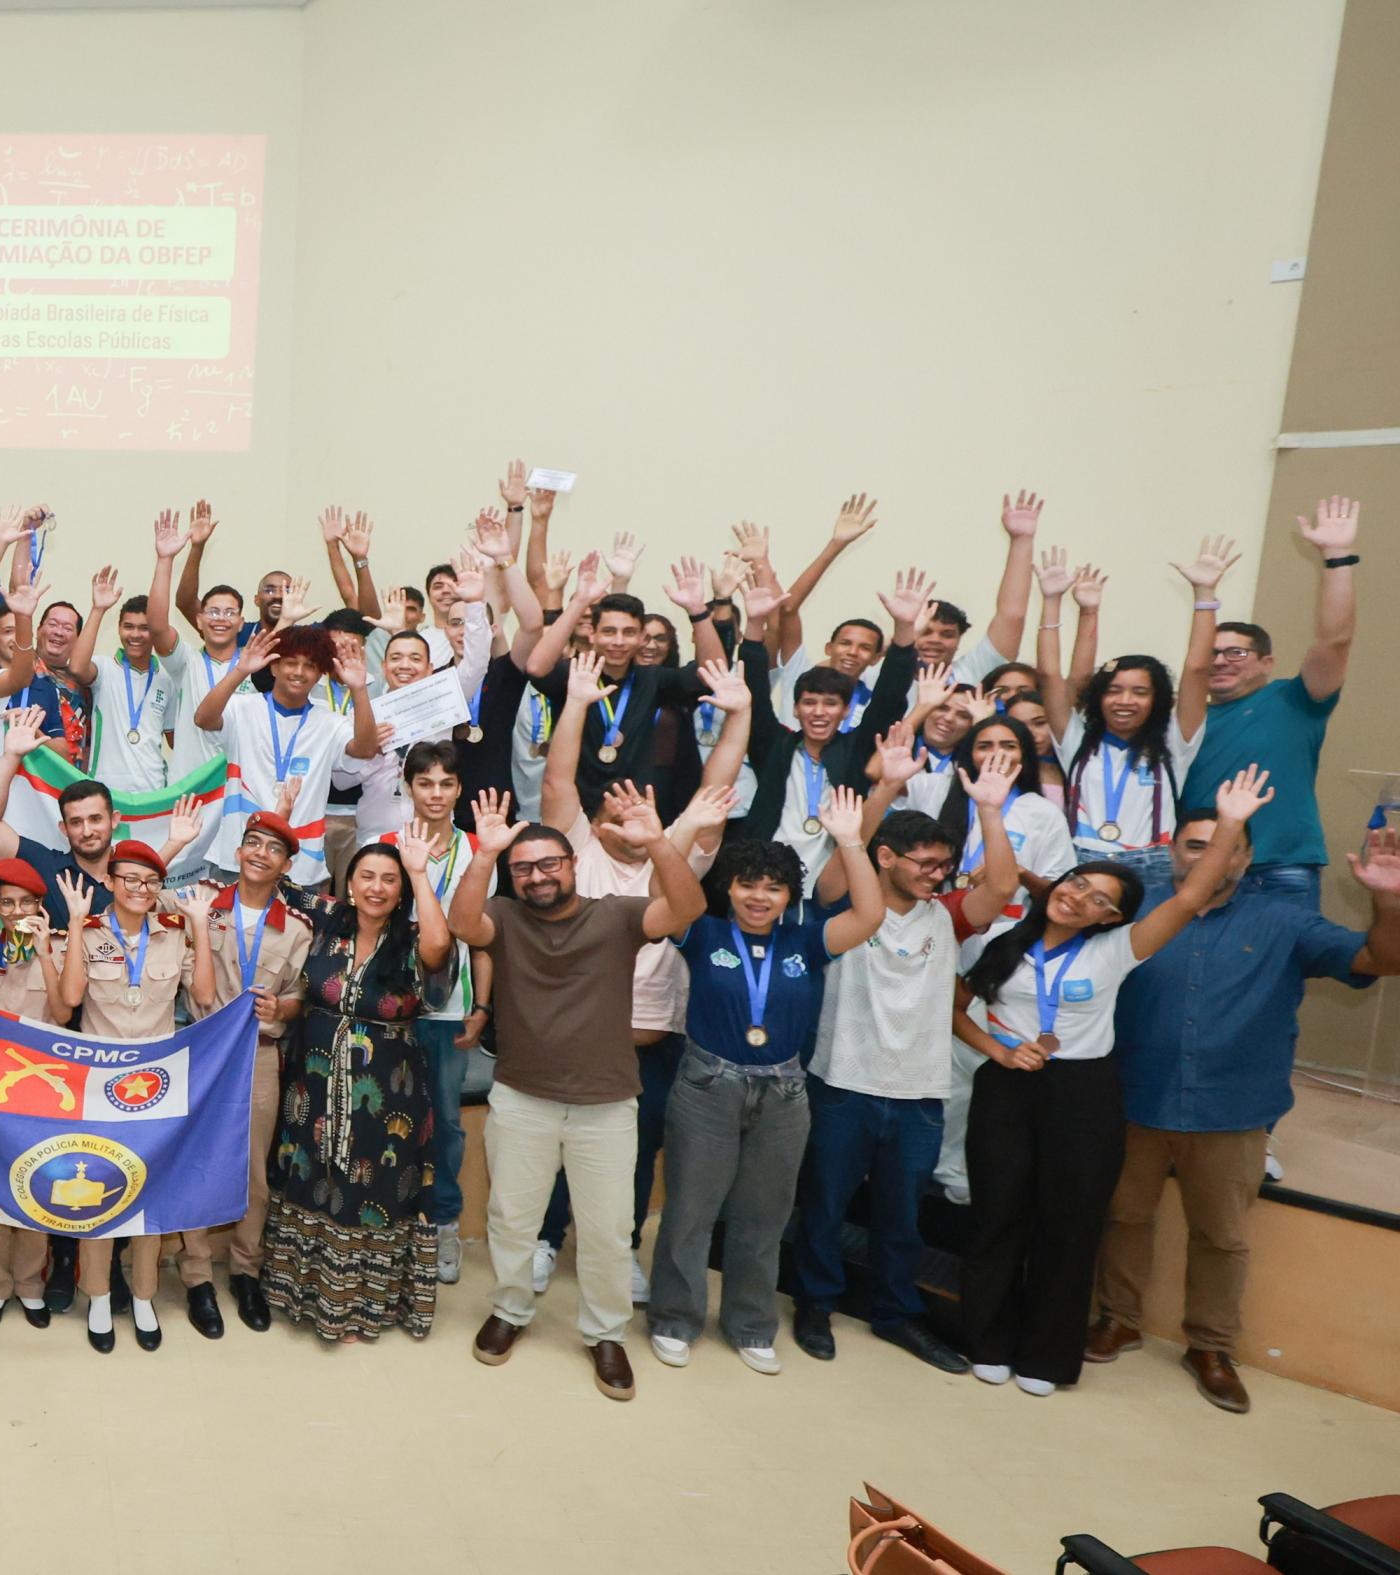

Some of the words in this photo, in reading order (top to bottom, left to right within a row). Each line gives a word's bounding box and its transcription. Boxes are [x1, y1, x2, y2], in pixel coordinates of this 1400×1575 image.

[136, 218, 166, 238] DE
[100, 245, 132, 264] DA
[139, 245, 212, 265] OBFEP
[46, 304, 126, 323] Brasileira
[132, 305, 153, 323] de
[158, 303, 209, 323] Física
[26, 331, 92, 349] Escolas
[98, 330, 172, 350] Públicas
[51, 1042, 141, 1064] CPMC
[24, 1157, 38, 1168] DA
[81, 1140, 124, 1161] MILITAR
[122, 1159, 137, 1171] DE
[40, 1215, 105, 1230] TIRADENTES
